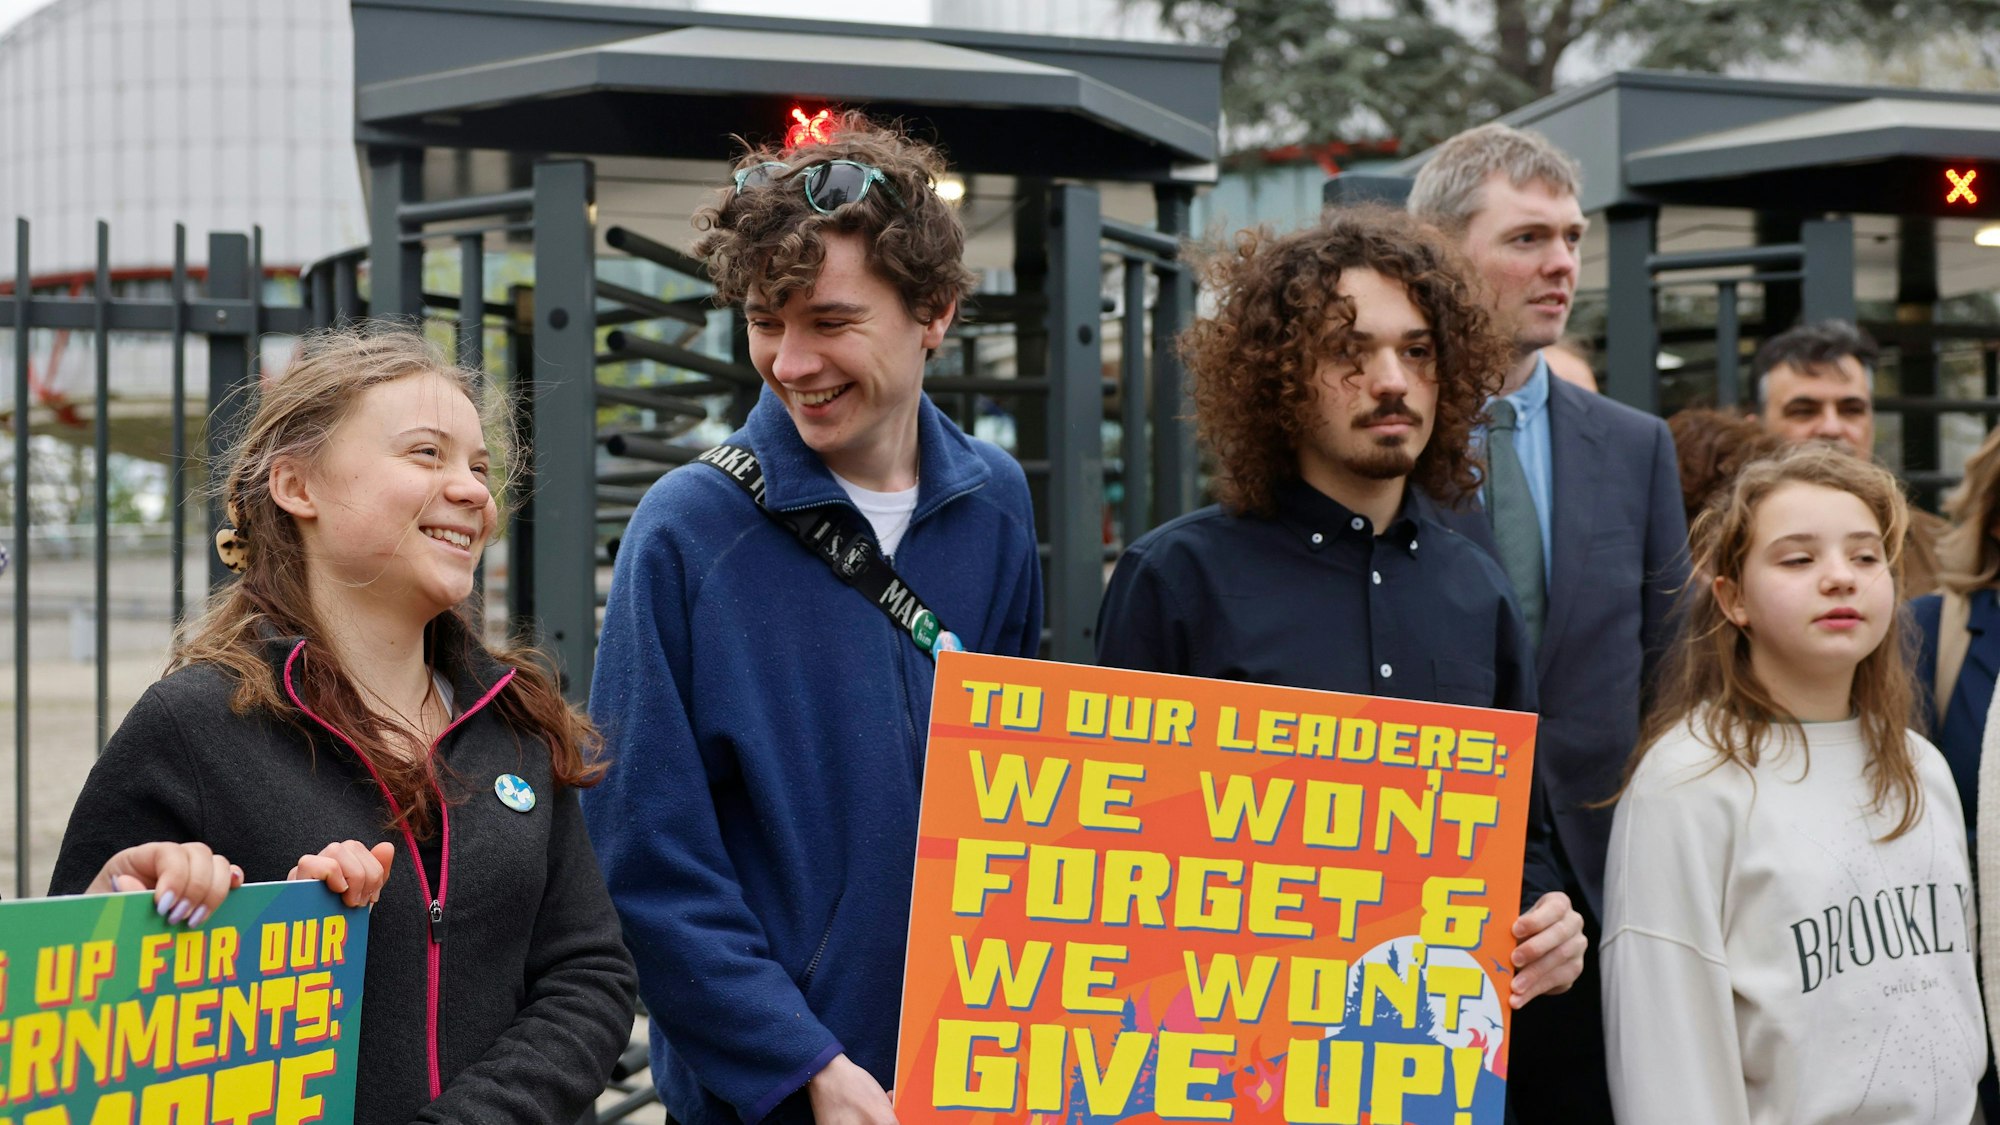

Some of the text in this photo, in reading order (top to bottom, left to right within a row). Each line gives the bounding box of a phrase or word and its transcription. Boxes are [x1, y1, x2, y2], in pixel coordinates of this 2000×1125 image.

[917, 629, 932, 647] him
[923, 615, 935, 630] he
[962, 680, 1507, 776] TO OUR LEADERS:
[969, 749, 1498, 858] WE WON'T
[952, 837, 1490, 951] FORGET &
[35, 940, 116, 1007] UP
[139, 926, 239, 991] FOR
[259, 914, 347, 973] OUR
[950, 935, 1484, 1031] WE WON'T
[0, 1048, 337, 1125] OTE
[932, 1019, 1484, 1125] GIVE UP!
